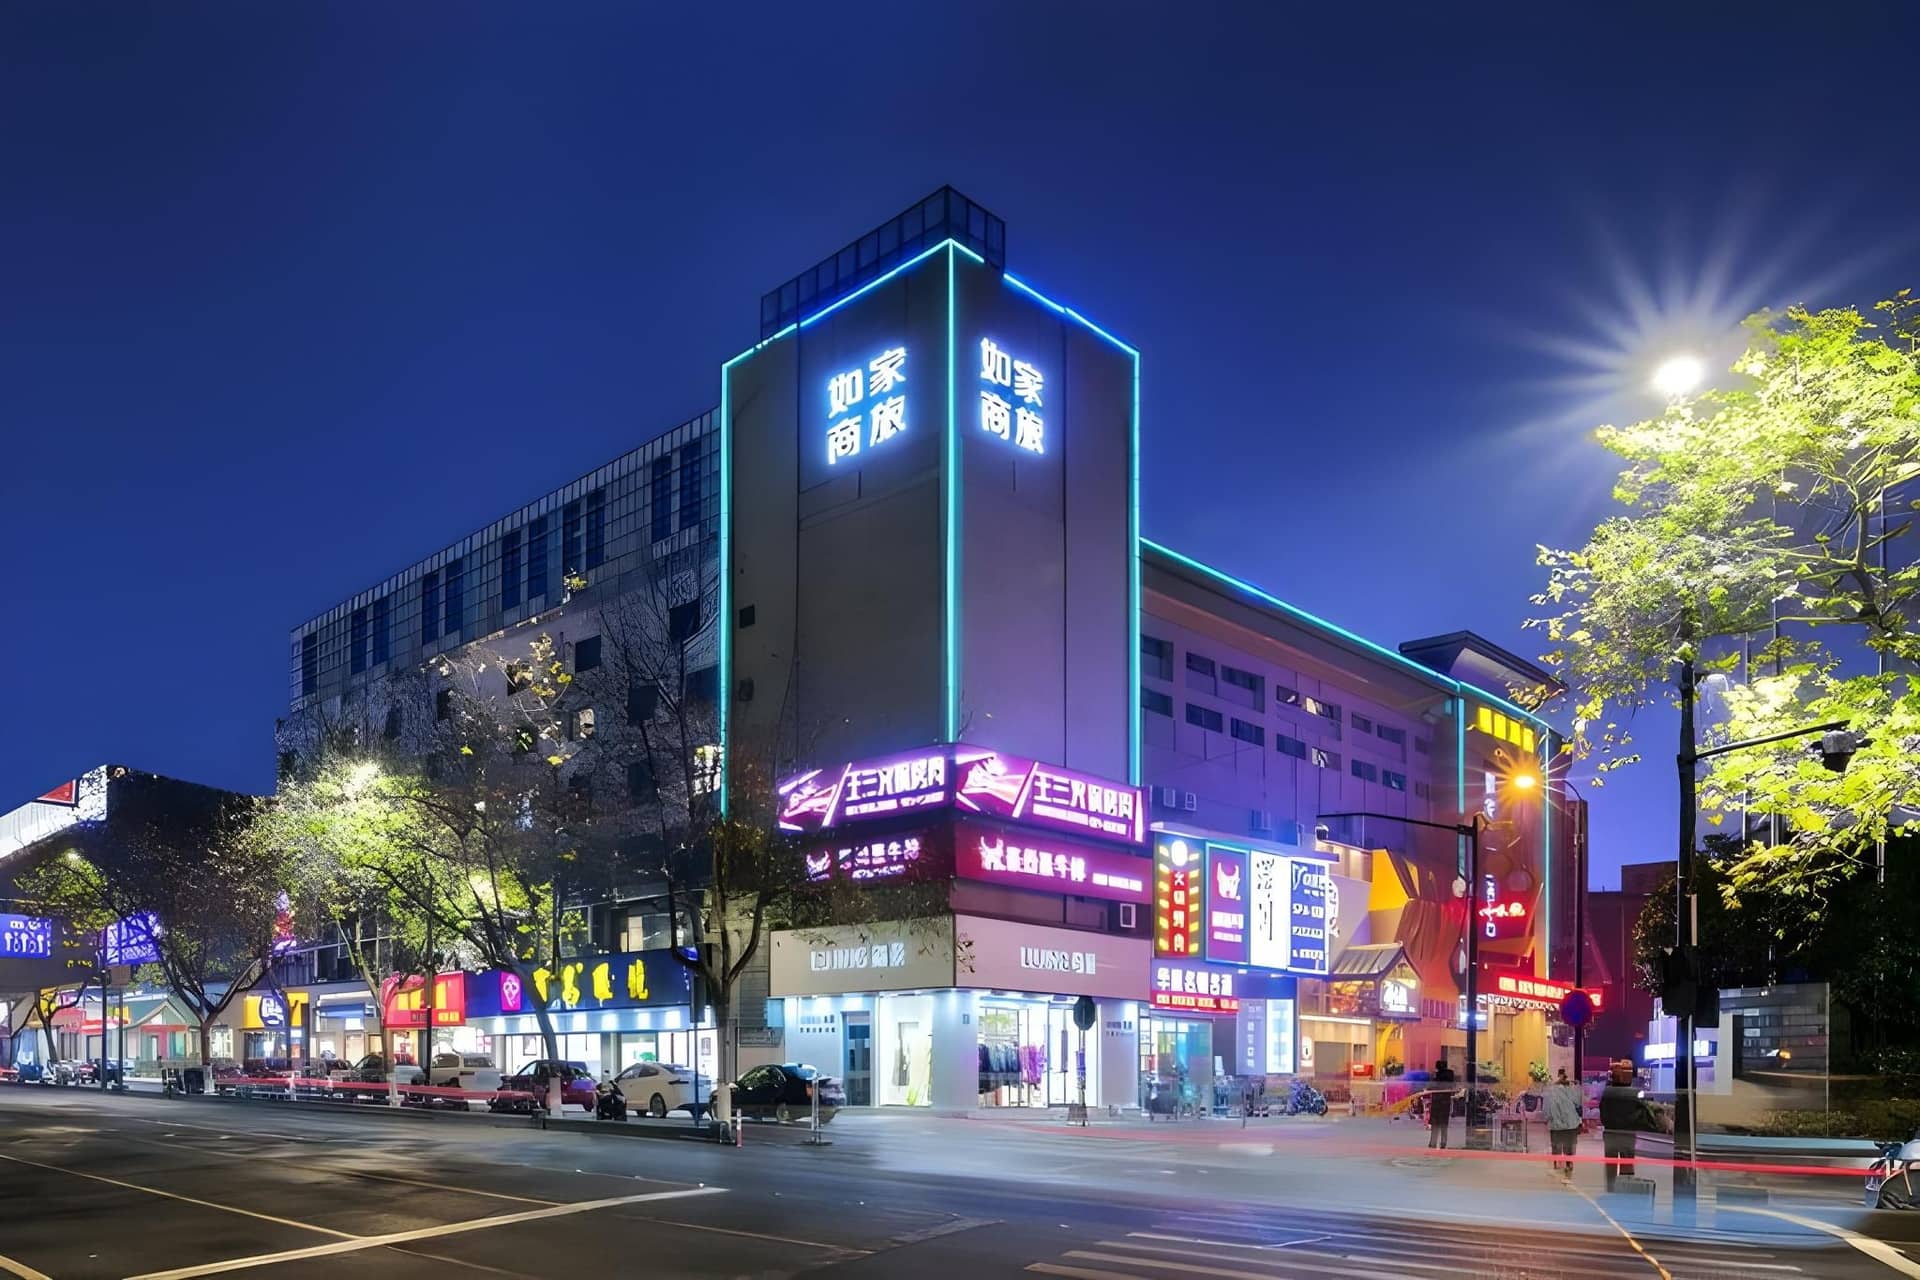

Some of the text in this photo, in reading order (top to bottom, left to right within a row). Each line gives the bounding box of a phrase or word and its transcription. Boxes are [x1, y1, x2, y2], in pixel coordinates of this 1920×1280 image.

[828, 346, 907, 418] 如家
[980, 337, 1045, 407] 如家
[826, 395, 907, 465] 商旅
[980, 391, 1045, 454] 商旅
